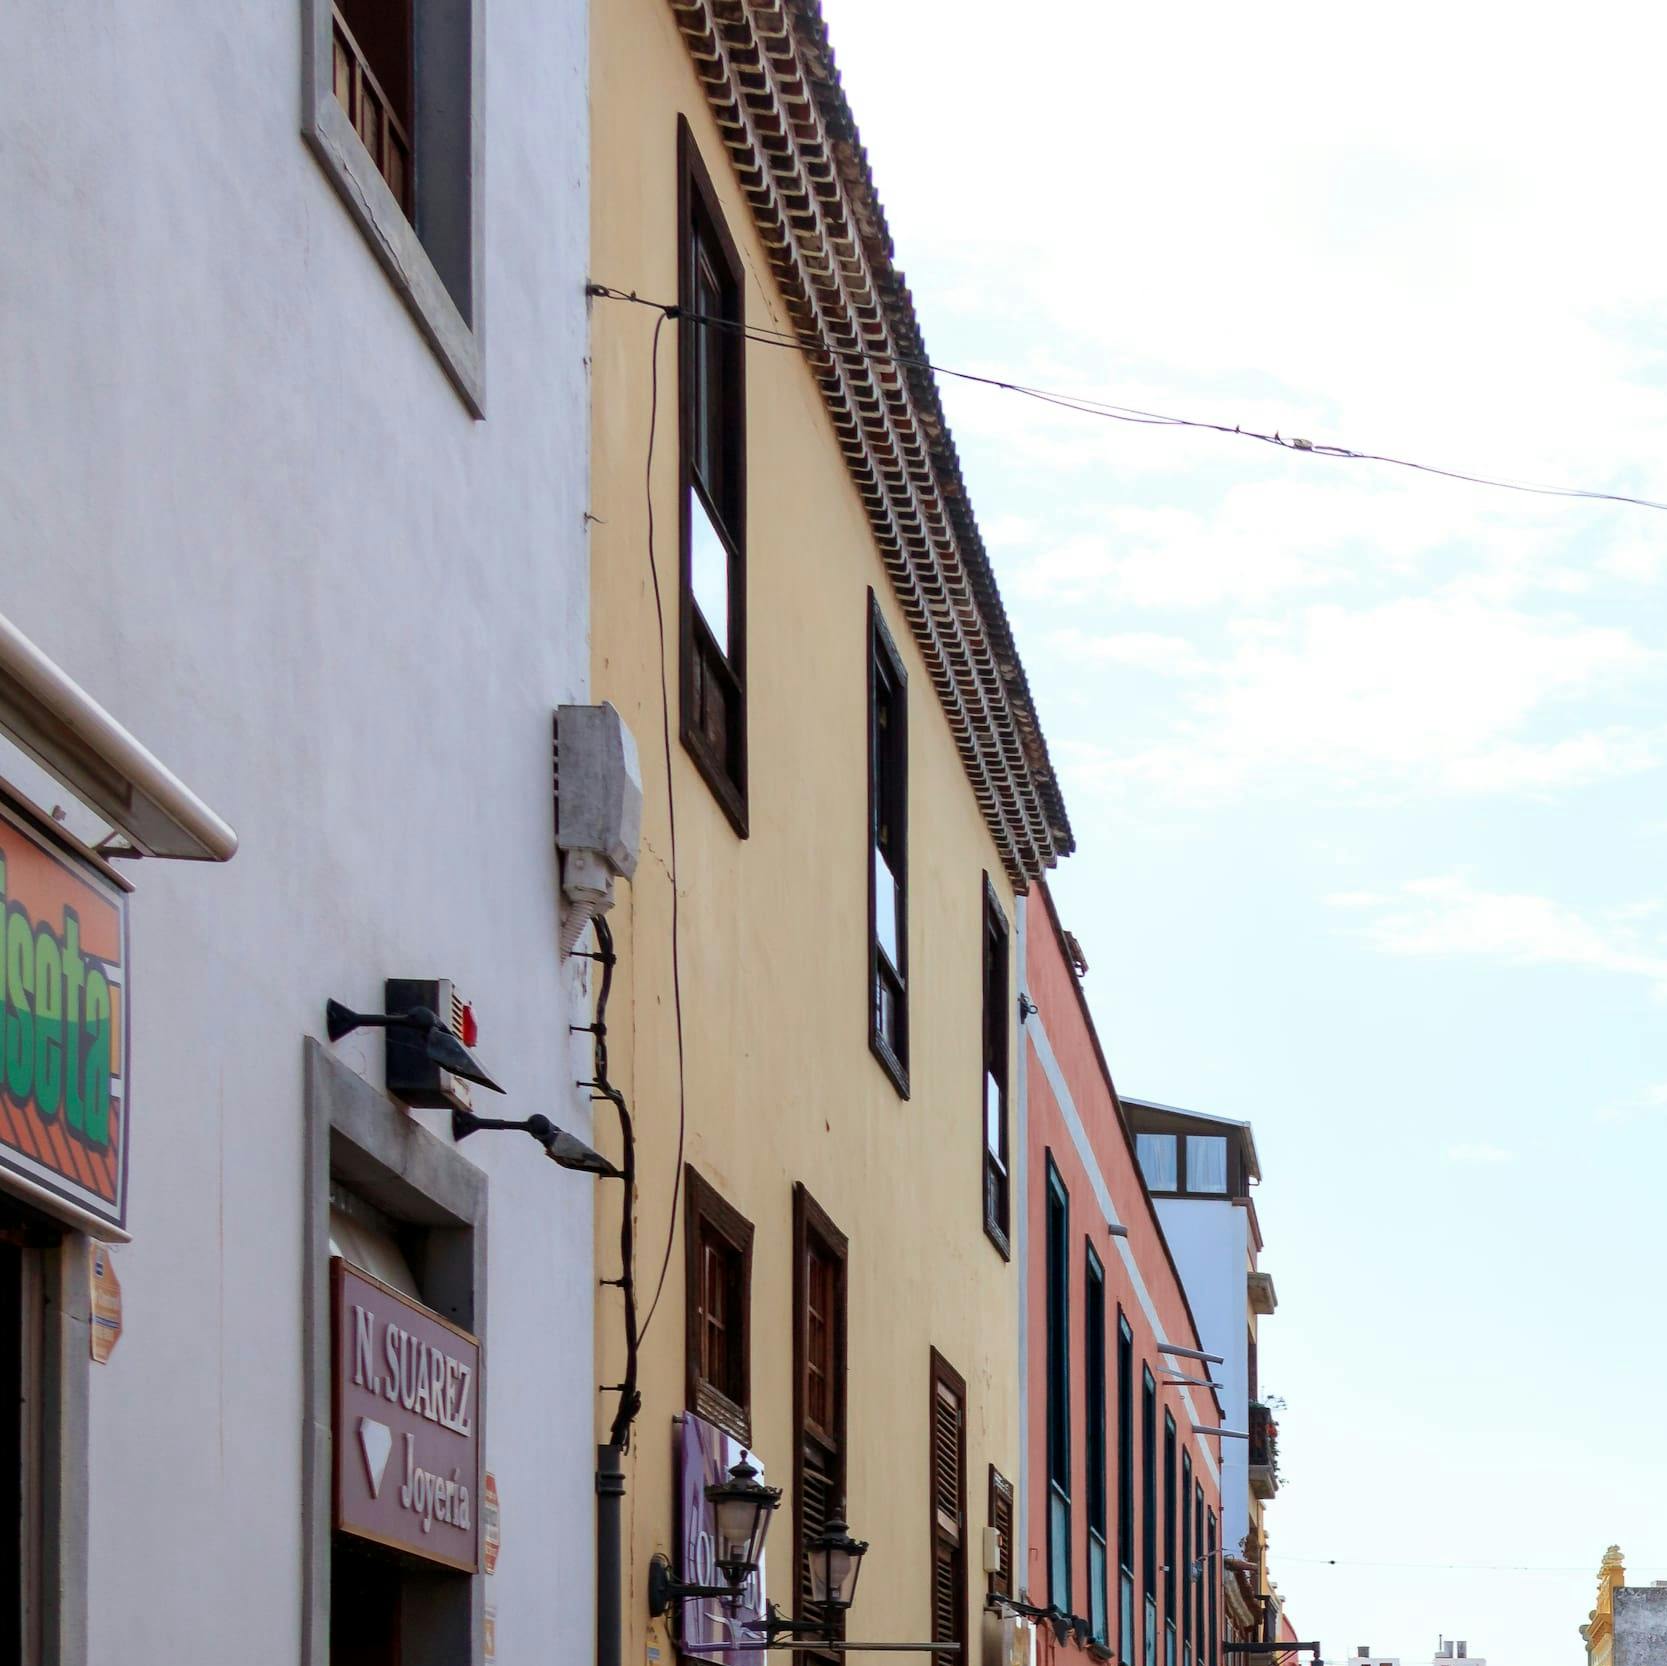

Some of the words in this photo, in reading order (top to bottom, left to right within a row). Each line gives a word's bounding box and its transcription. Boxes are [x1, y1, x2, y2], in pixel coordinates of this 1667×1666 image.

[352, 1304, 381, 1395] N.
[385, 1322, 472, 1438] SUAREZ
[401, 1431, 472, 1533] Joyería
